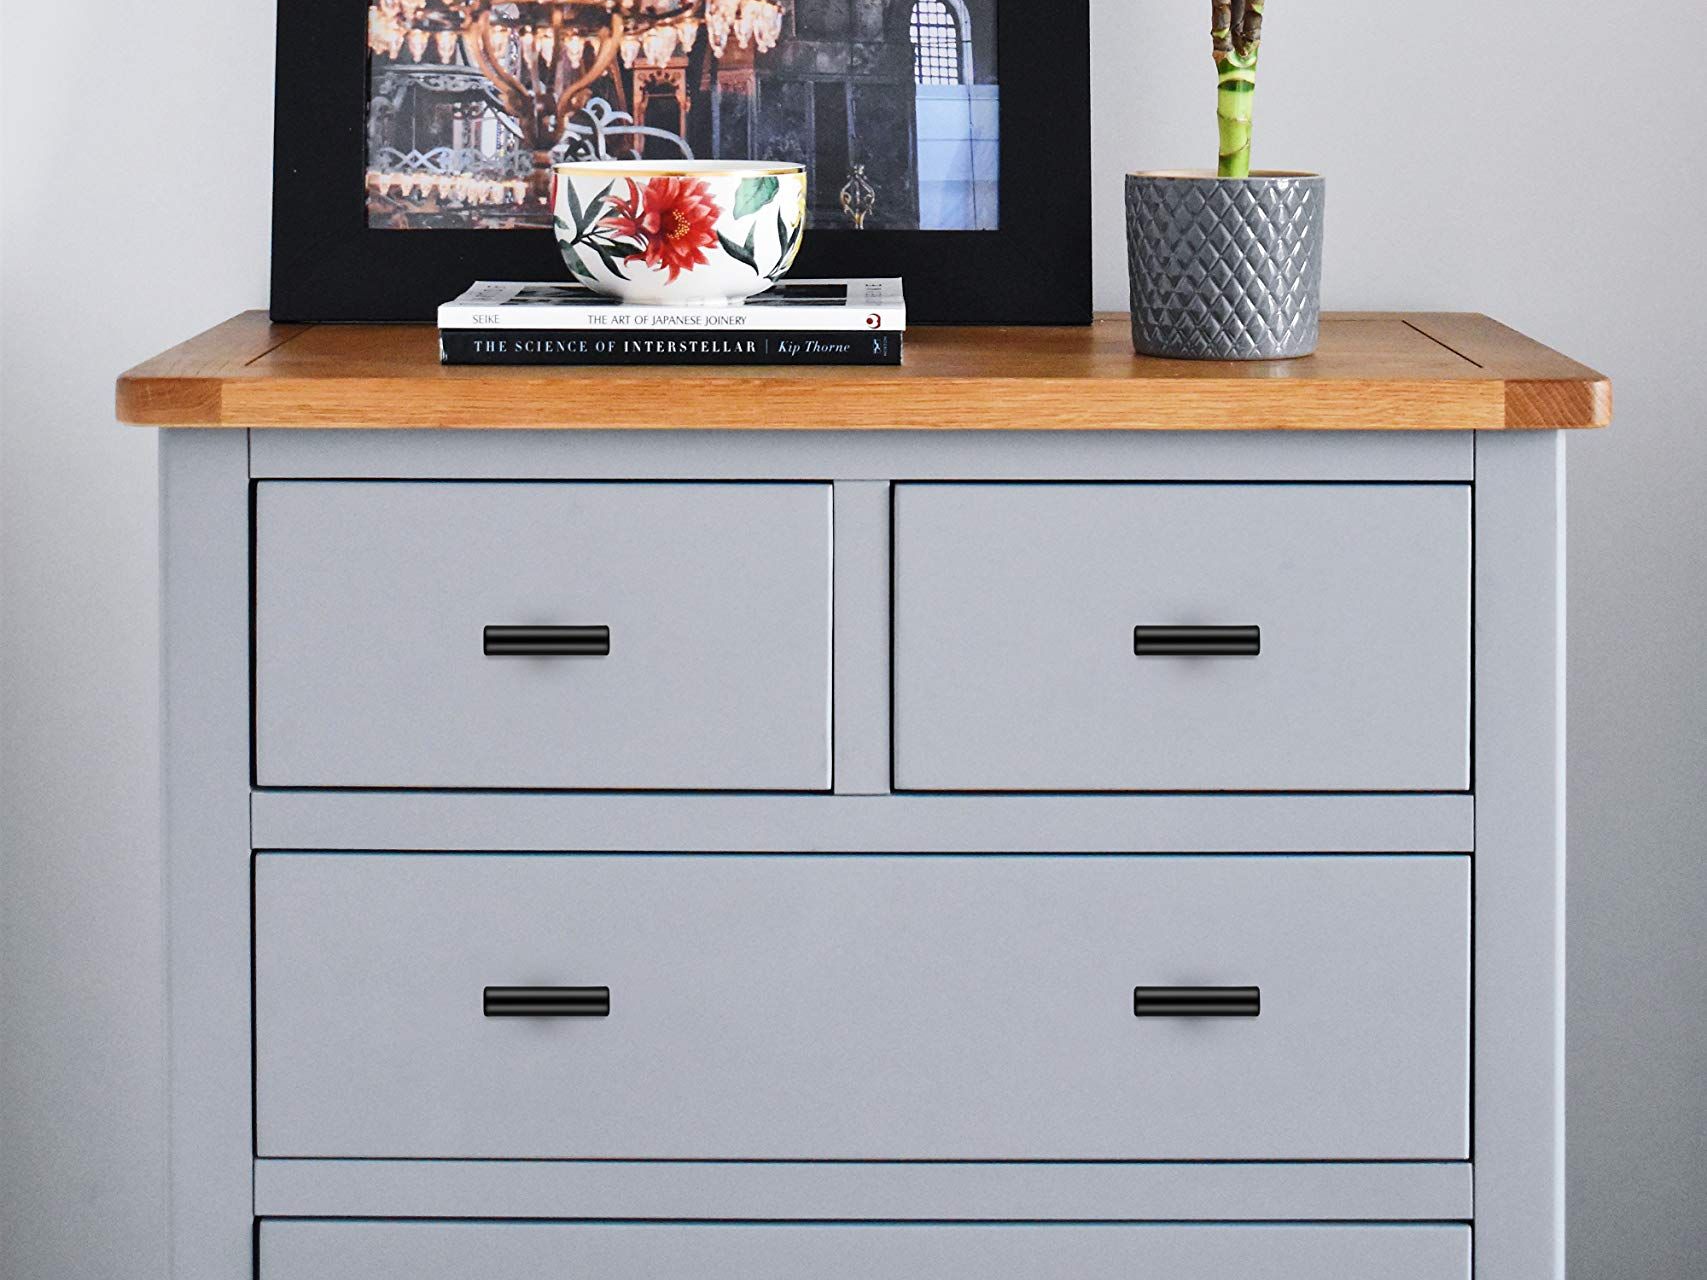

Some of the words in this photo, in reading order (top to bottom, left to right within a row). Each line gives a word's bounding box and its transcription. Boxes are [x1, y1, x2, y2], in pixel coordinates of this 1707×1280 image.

[472, 314, 500, 325] SEIKE
[587, 314, 607, 325] THE
[611, 314, 632, 325] ART
[634, 314, 649, 325] OF
[651, 314, 702, 327] JAPANESE
[704, 314, 747, 327] JOINERY
[473, 340, 507, 352] THE
[514, 340, 588, 352] SCIENCE
[595, 340, 616, 352] OF
[624, 340, 756, 352] INTERSTELLAR
[778, 340, 801, 357] Kip
[804, 340, 850, 352] Thorne
